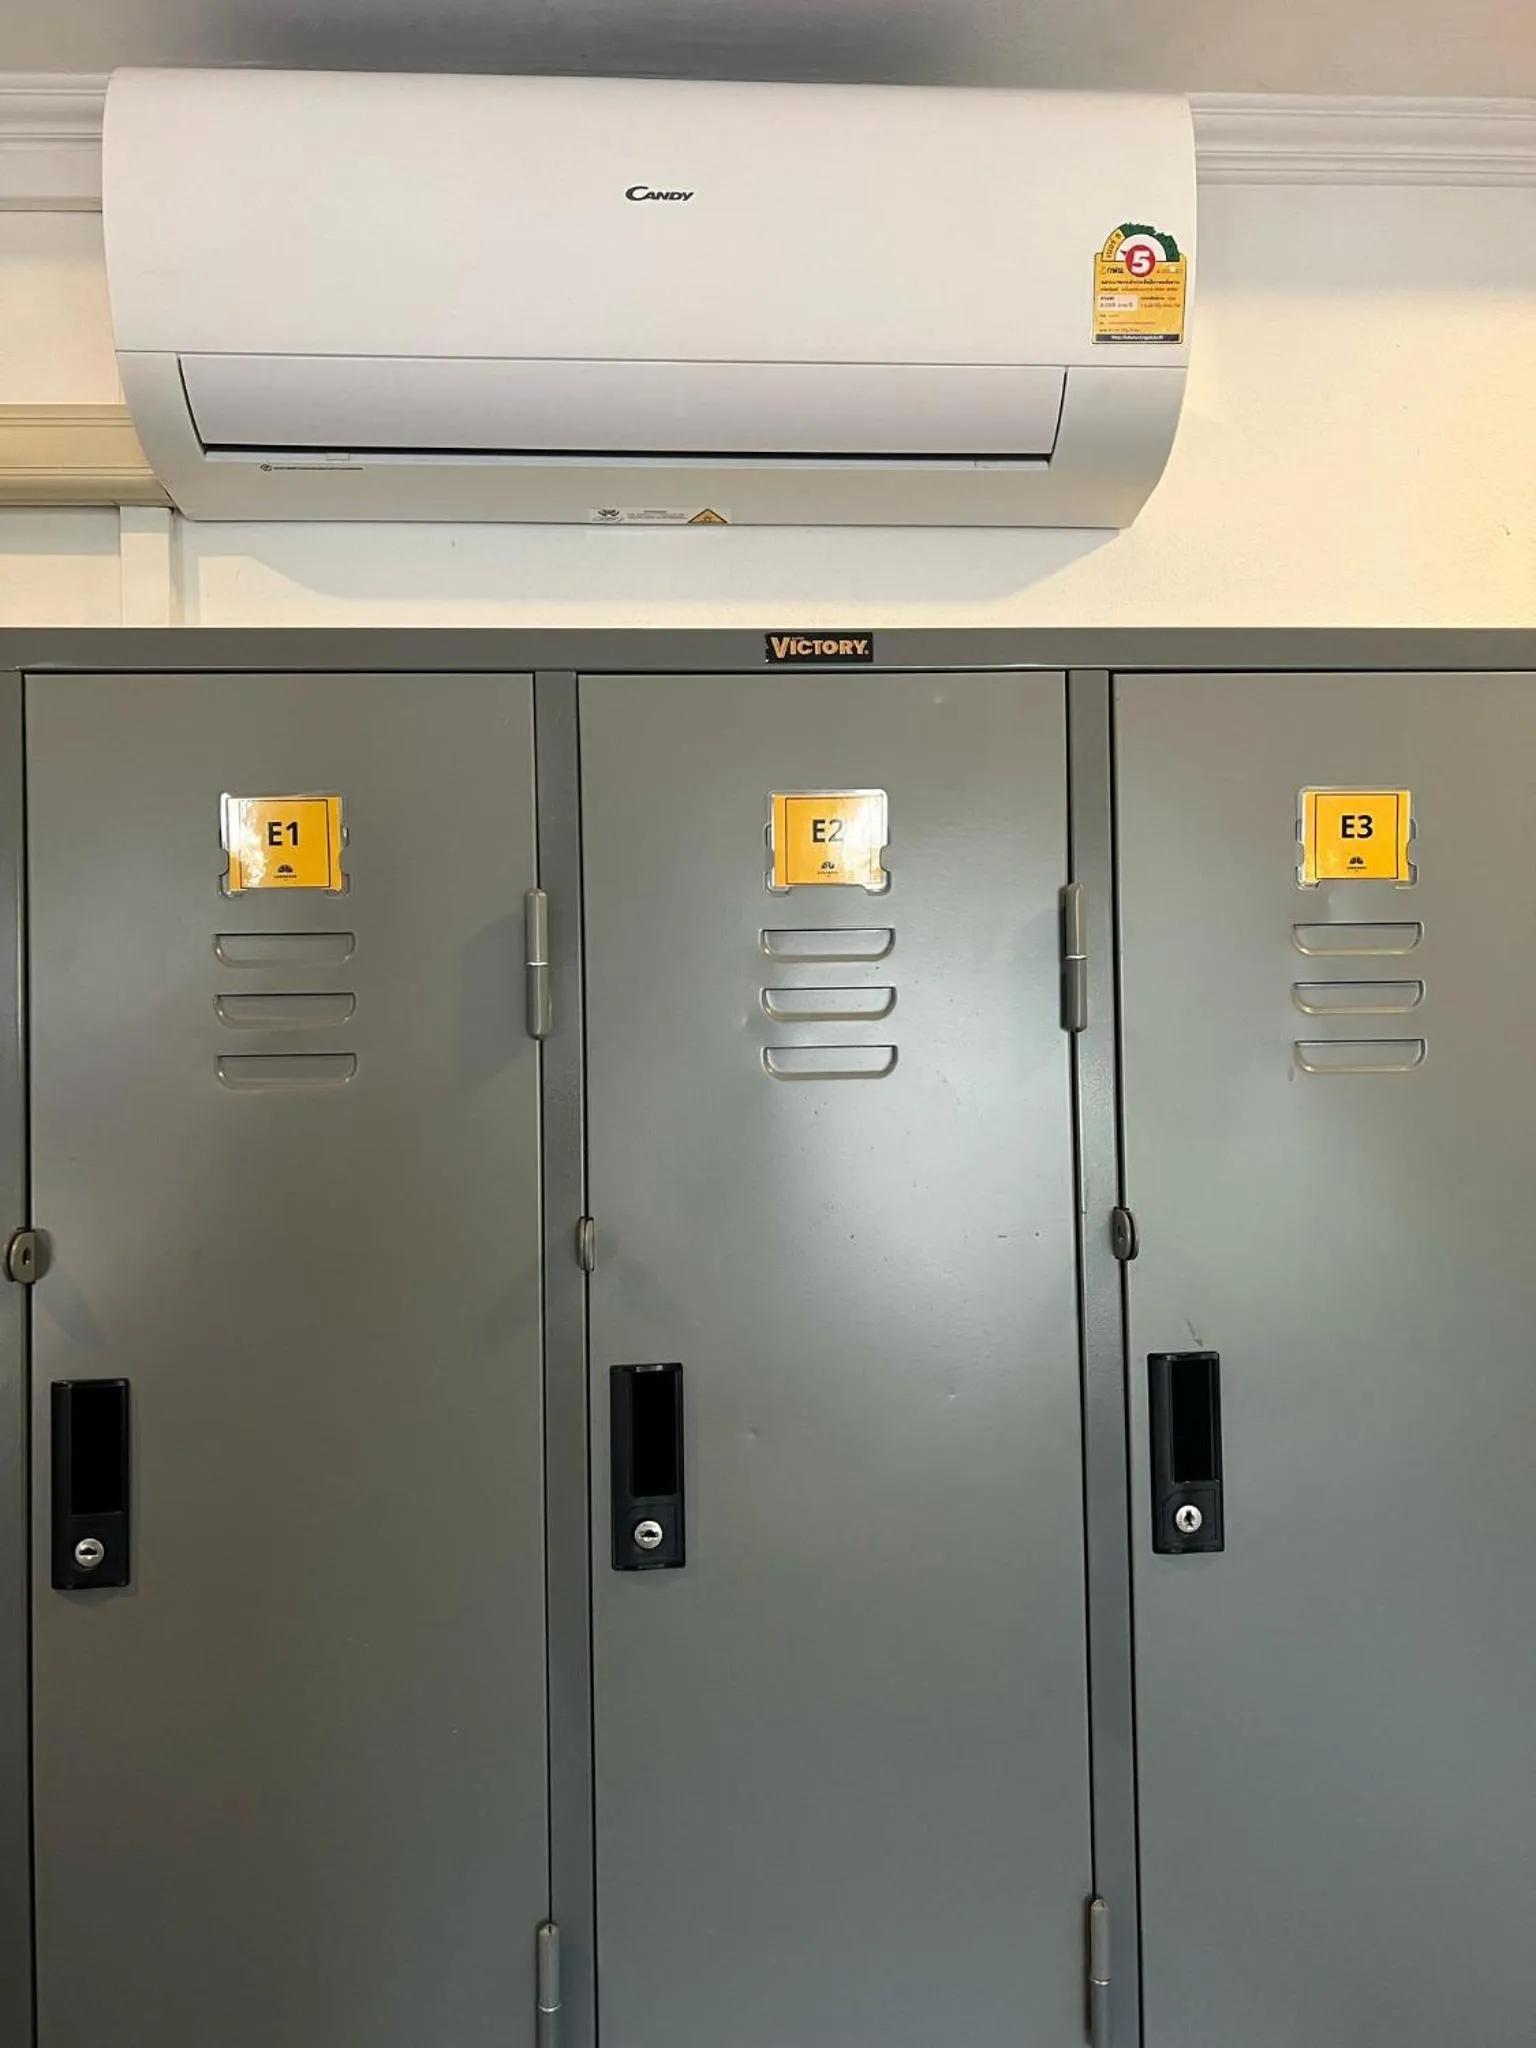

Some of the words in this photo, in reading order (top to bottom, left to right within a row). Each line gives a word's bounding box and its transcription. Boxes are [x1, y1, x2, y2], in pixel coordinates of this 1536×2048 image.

[625, 186, 694, 201] CANDY
[1131, 250, 1151, 274] 5
[268, 822, 298, 846] E1
[812, 819, 844, 843] E2
[1341, 815, 1373, 839] E3
